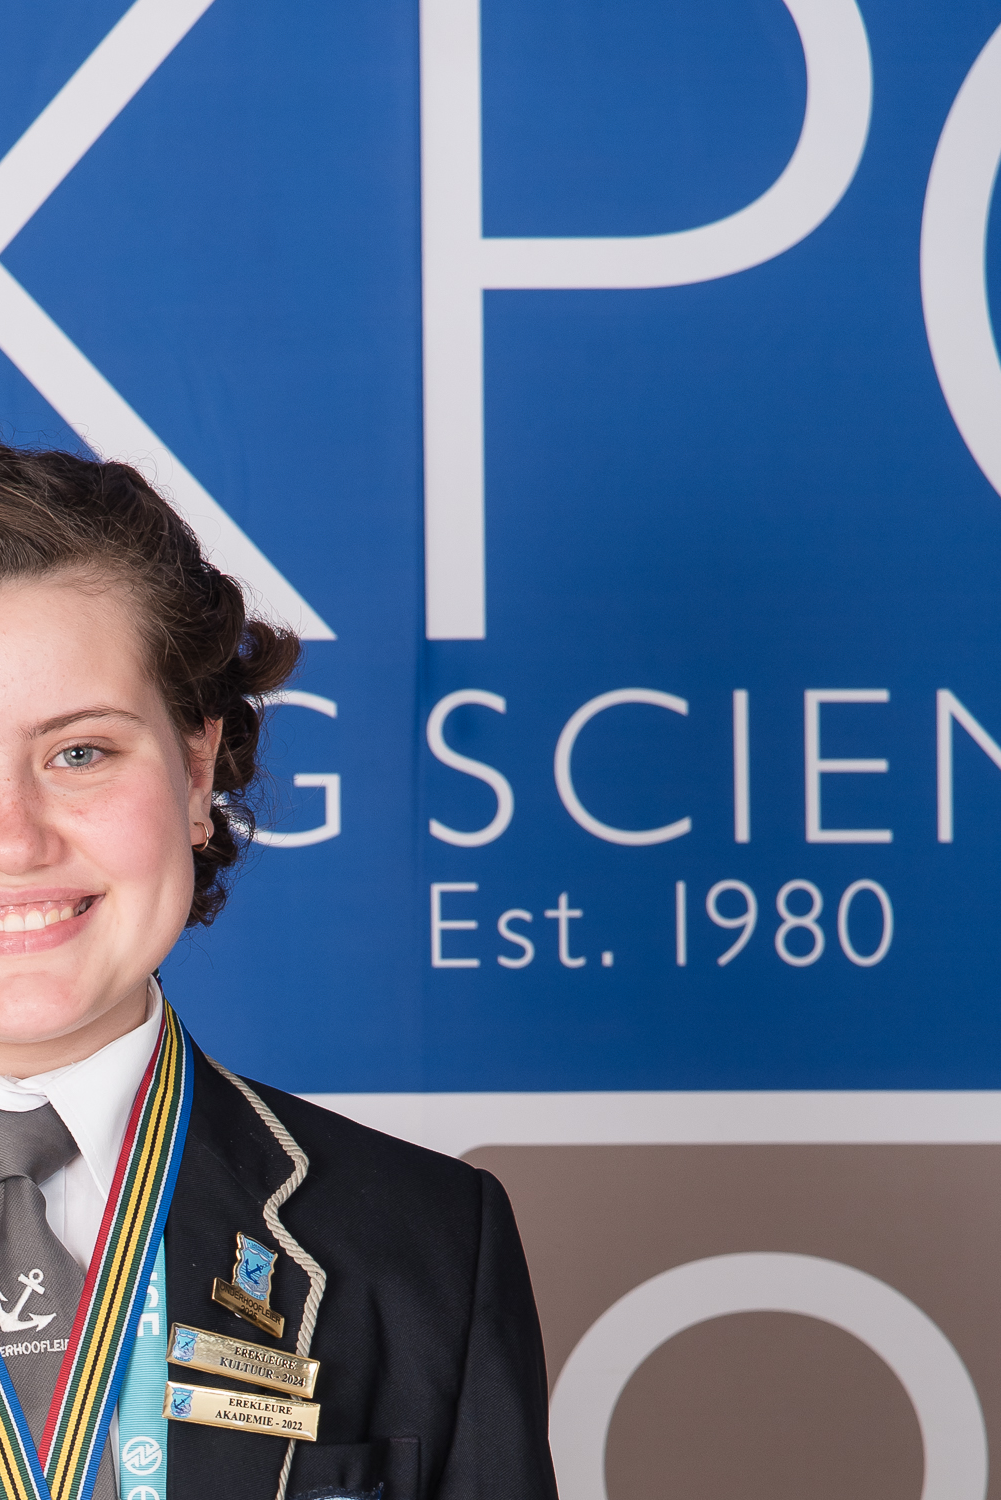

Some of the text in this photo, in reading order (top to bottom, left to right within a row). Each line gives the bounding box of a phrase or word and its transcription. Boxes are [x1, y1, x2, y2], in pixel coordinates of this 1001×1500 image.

[431, 879, 895, 968] Est. 1980
[234, 1346, 297, 1370] EREKLEURE
[220, 1356, 274, 1379] KULTUUR
[283, 1373, 304, 1387] 2024
[229, 1398, 292, 1415] EREKLEURE
[215, 1409, 274, 1427] AKADEMIE
[282, 1419, 303, 1431] 2022
